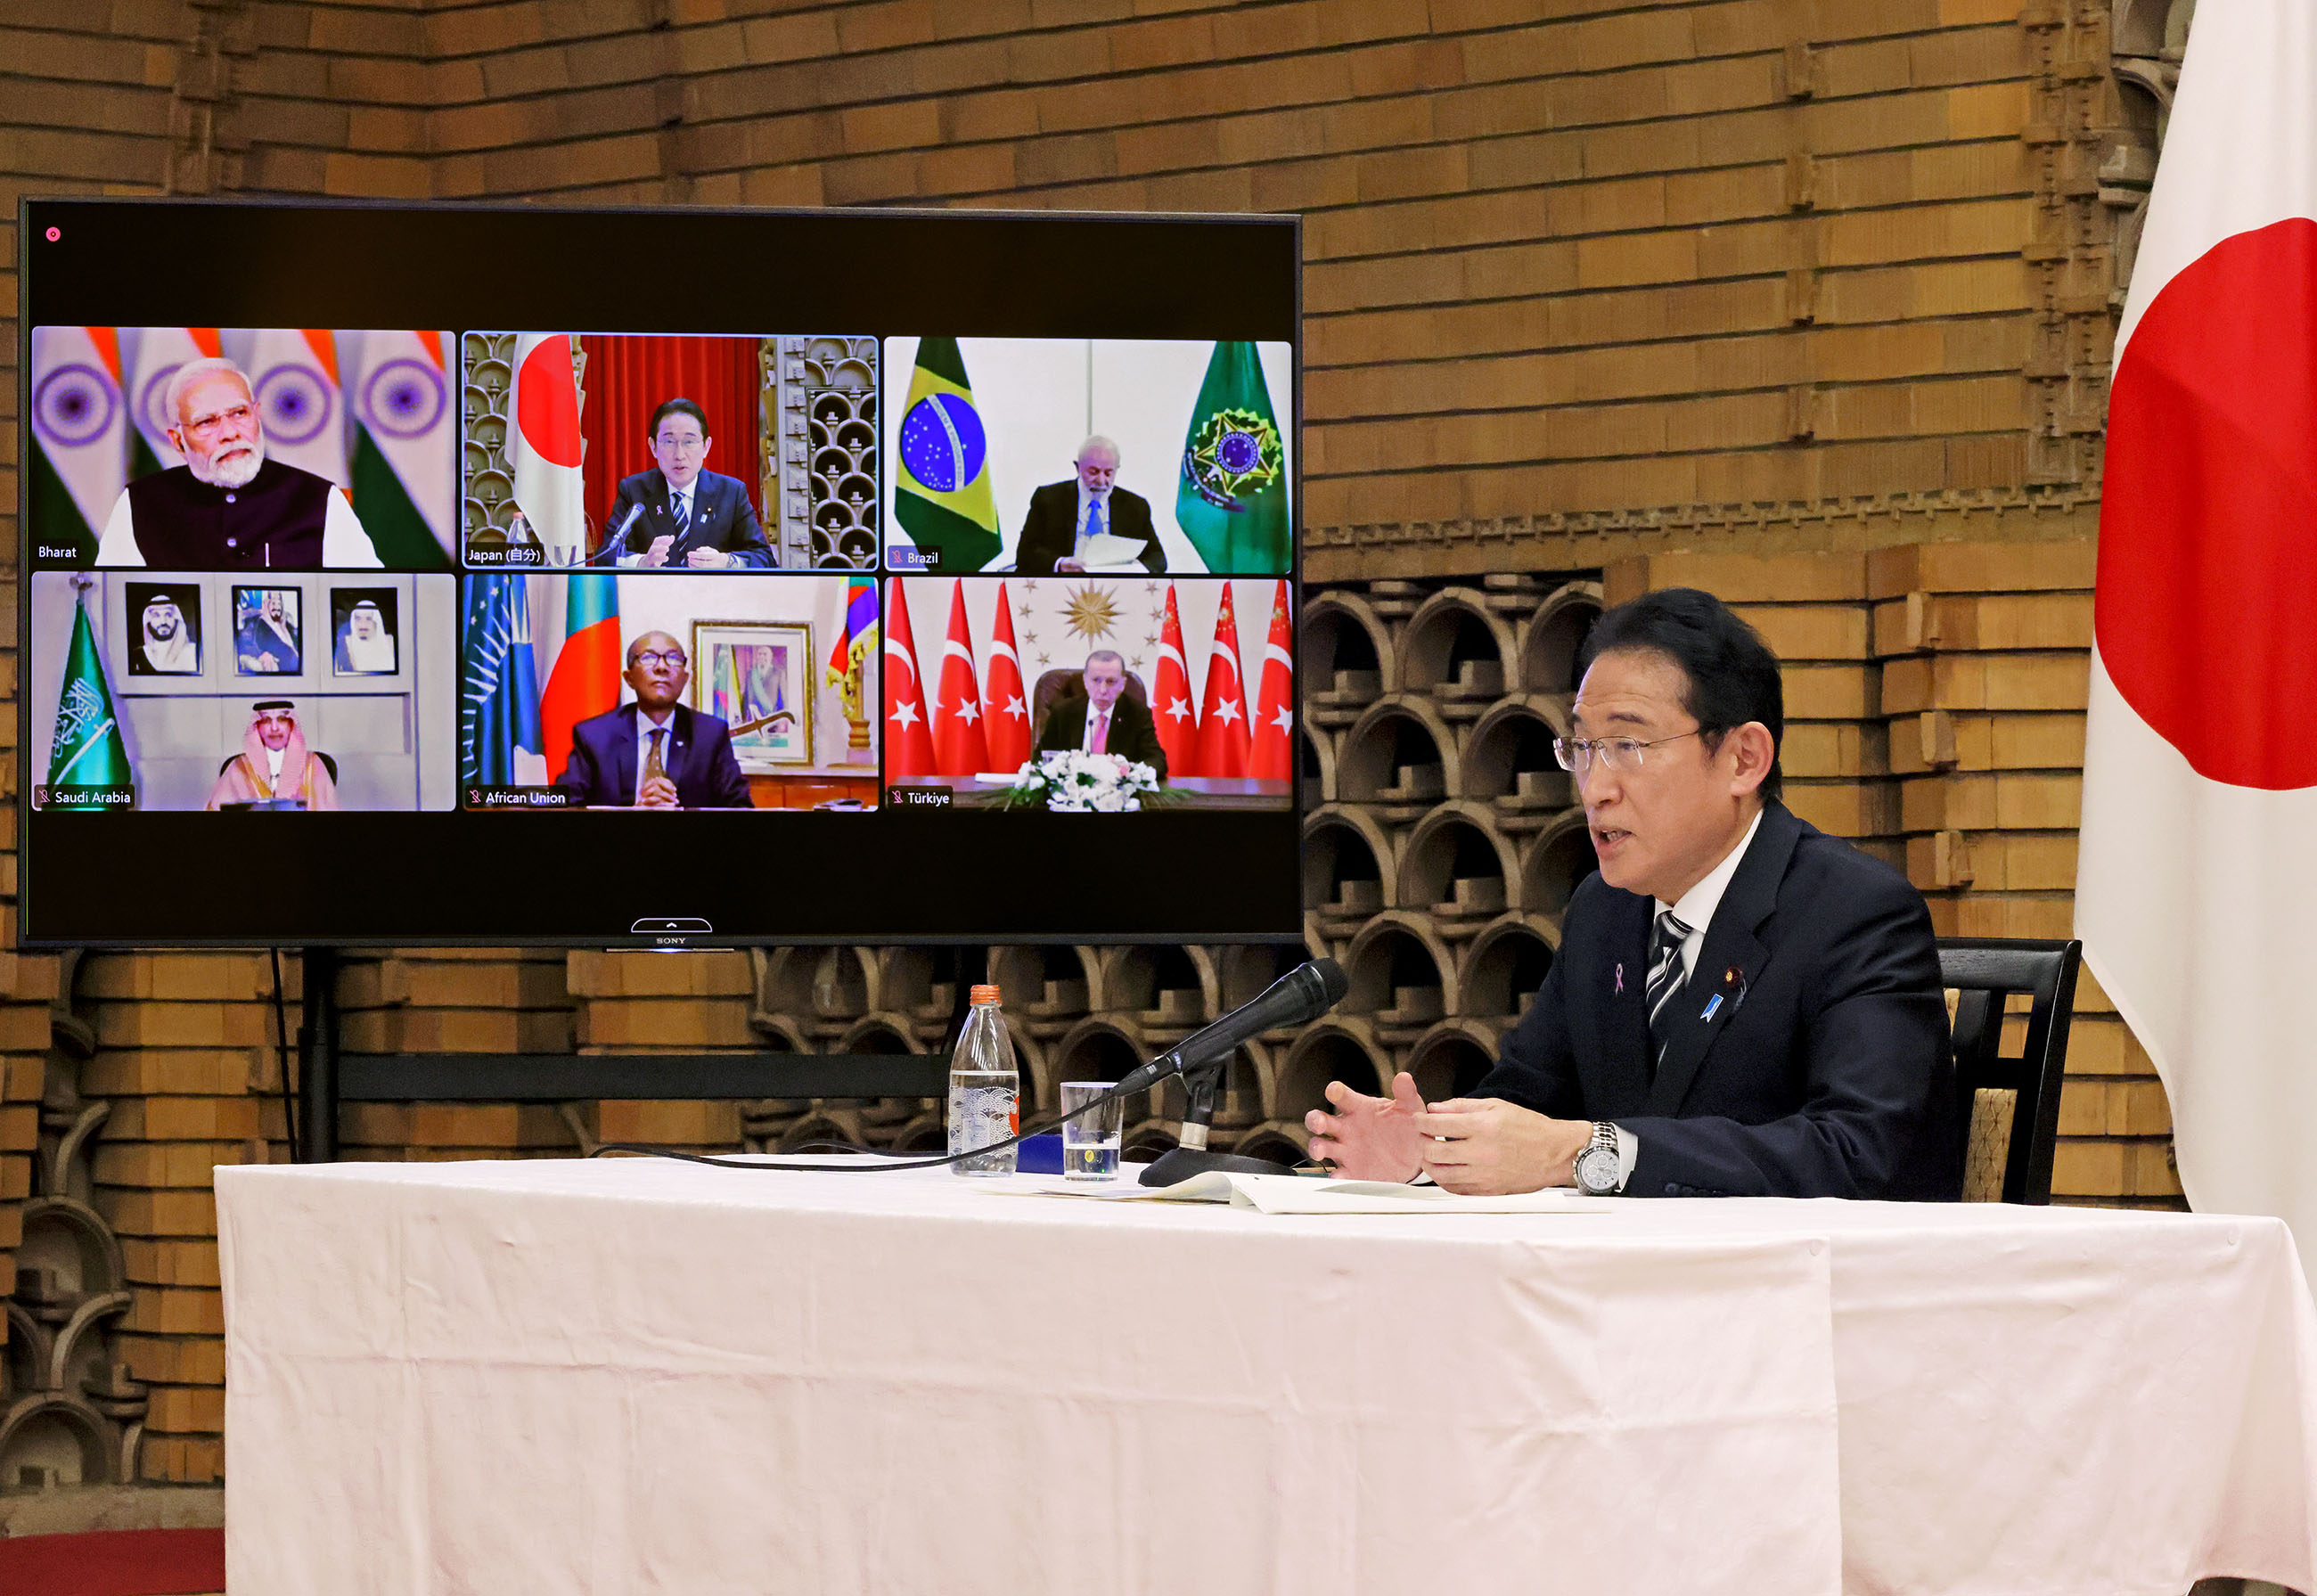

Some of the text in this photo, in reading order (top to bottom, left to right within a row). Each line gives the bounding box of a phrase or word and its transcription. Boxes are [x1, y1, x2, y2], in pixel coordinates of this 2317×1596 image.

[38, 545, 77, 558] Bharat
[469, 548, 541, 563] Japan (自分)
[907, 552, 938, 564] Brazil
[55, 790, 131, 804] Saudi Arabia
[486, 791, 566, 804] African Union
[907, 791, 950, 807] Türkiye
[656, 937, 686, 945] SONY
